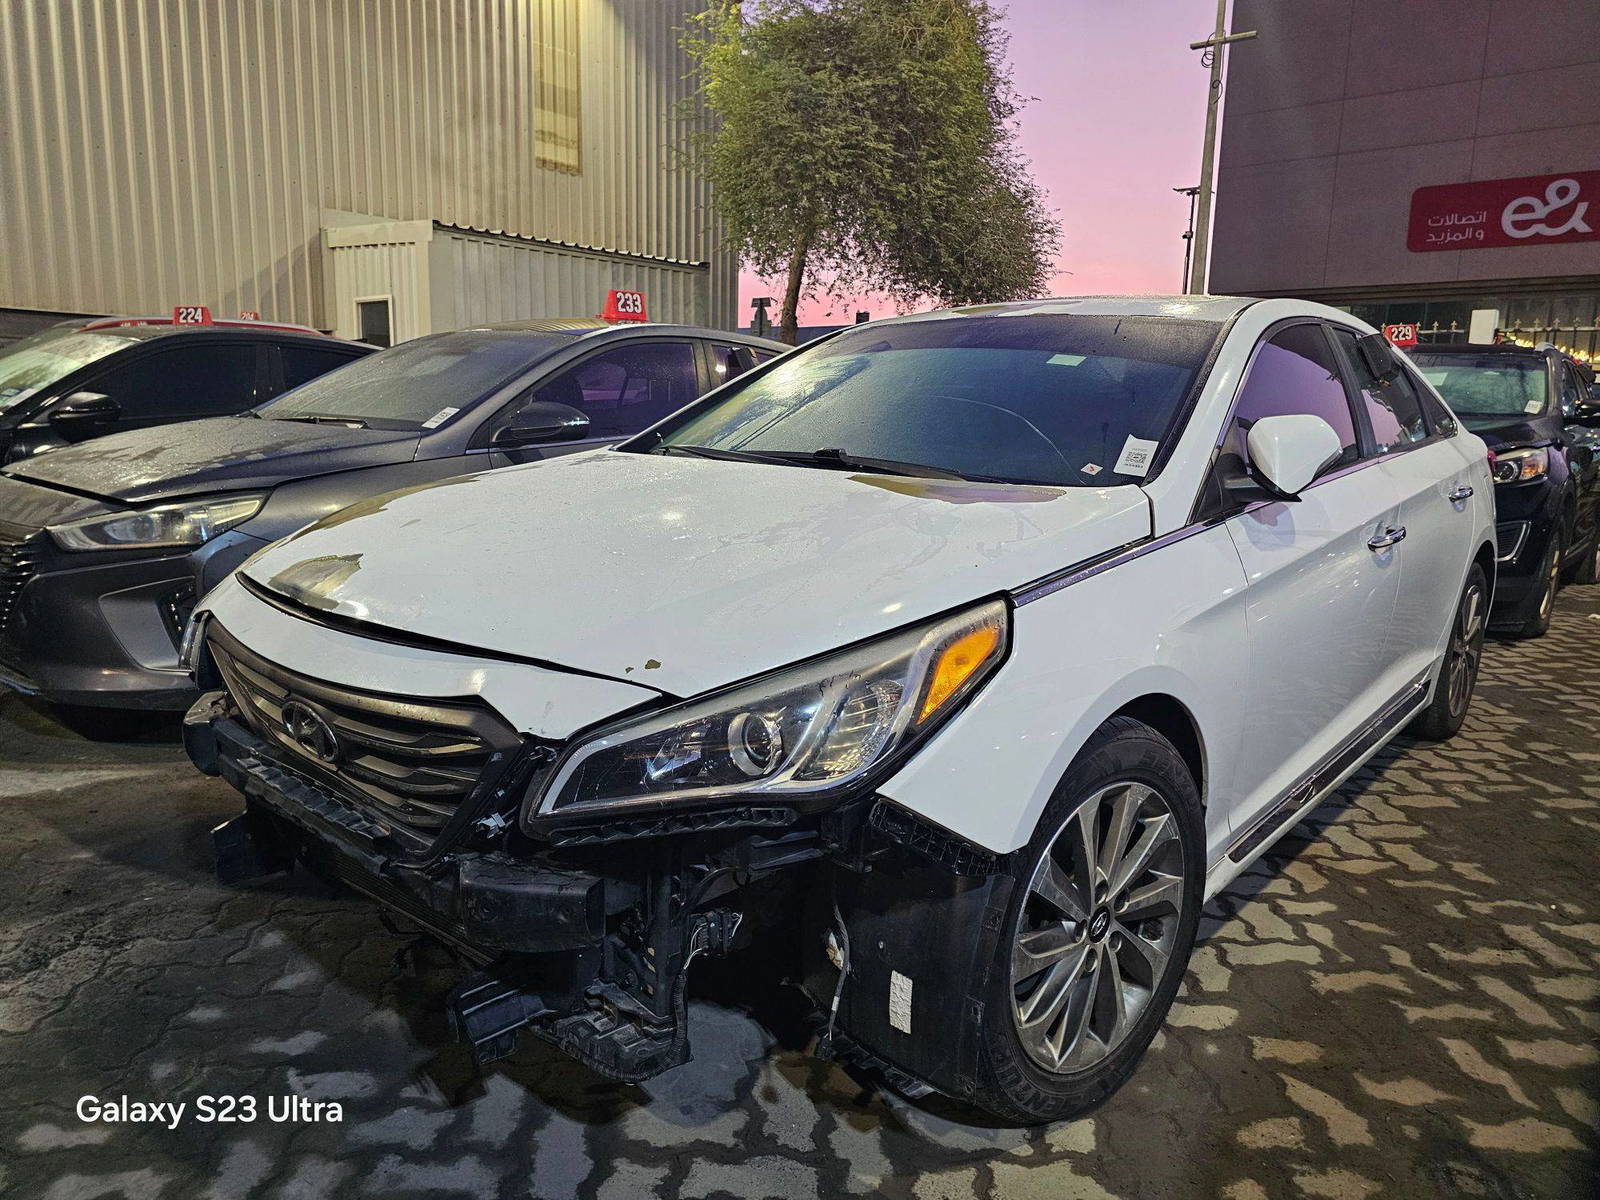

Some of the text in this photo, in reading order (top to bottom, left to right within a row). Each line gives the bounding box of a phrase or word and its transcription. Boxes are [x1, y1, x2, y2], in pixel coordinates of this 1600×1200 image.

[1428, 211, 1487, 227] اتصالات
[616, 292, 642, 313] 233
[179, 308, 203, 323] 224
[1391, 326, 1412, 341] 229
